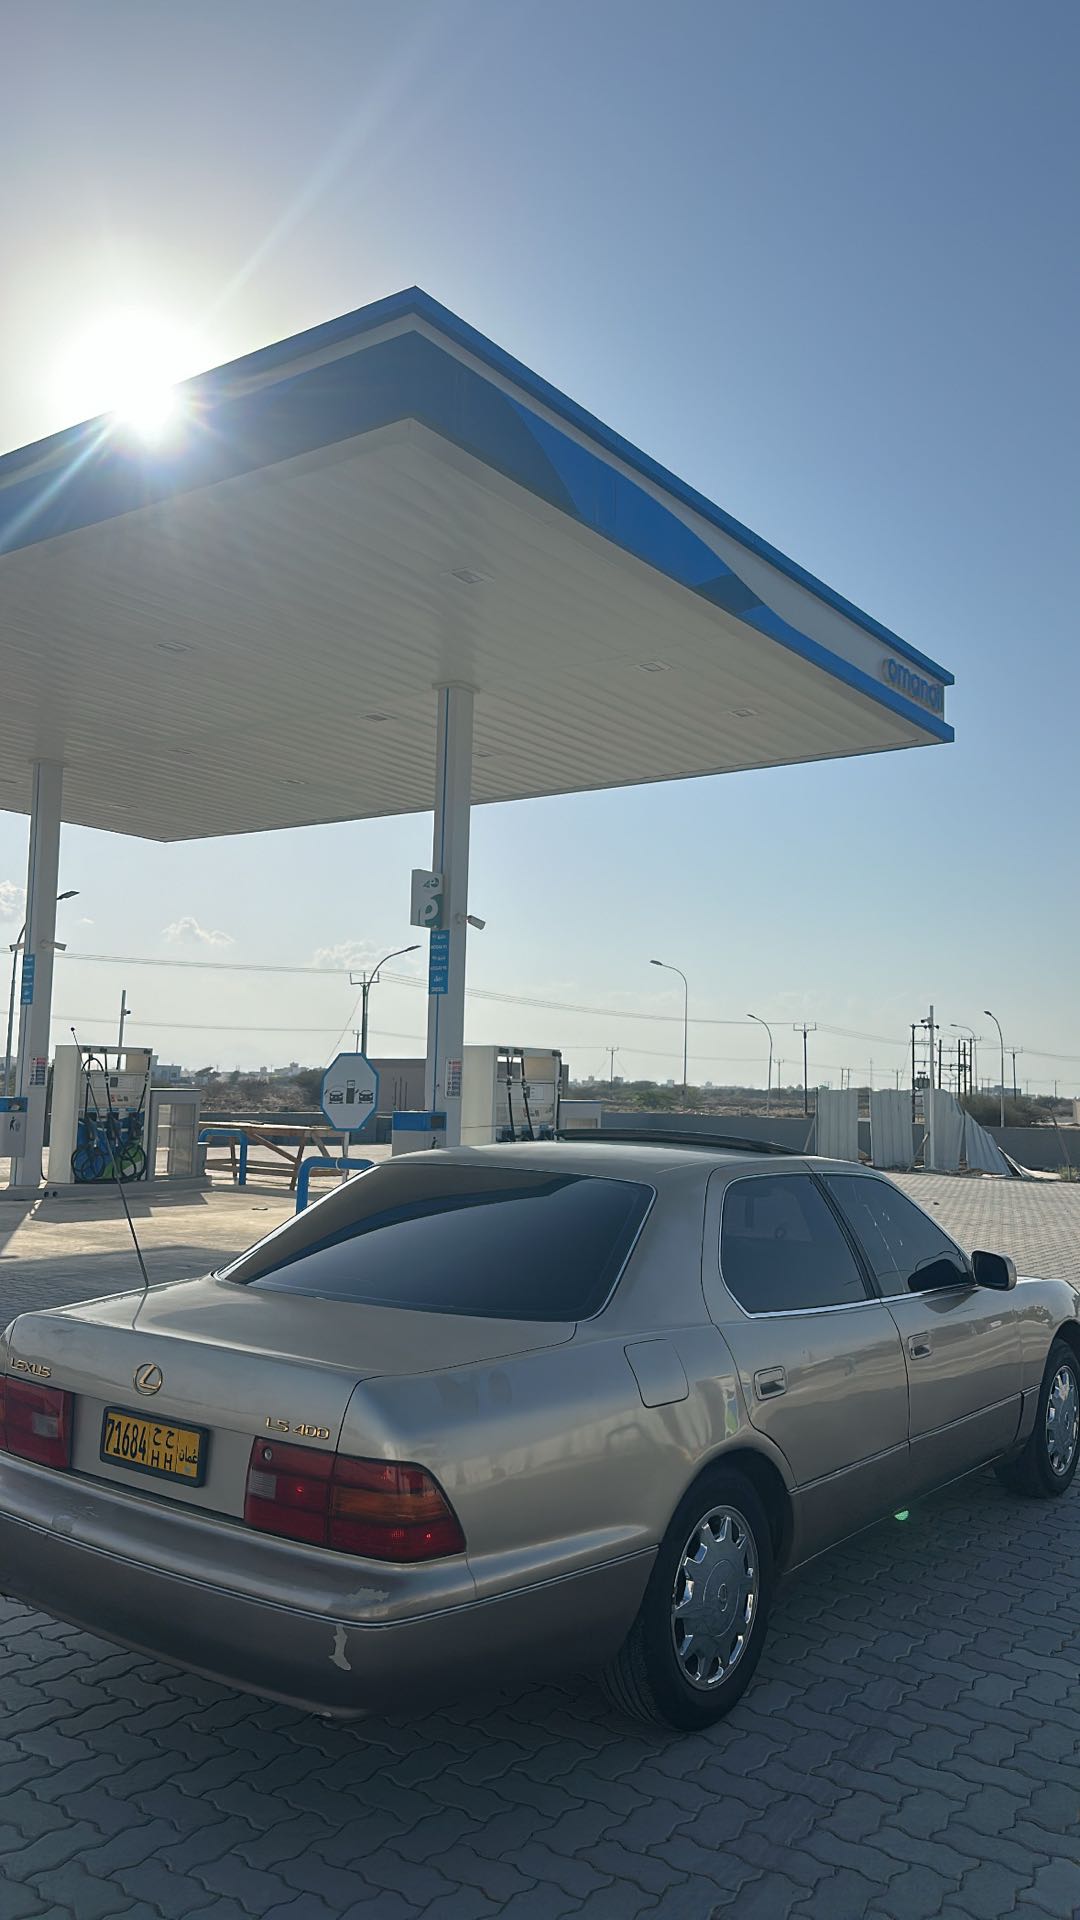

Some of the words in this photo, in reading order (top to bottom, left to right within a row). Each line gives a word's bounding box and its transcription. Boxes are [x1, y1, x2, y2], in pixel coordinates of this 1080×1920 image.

[10, 1357, 51, 1378] LEXUS
[105, 1418, 147, 1461] 71684
[266, 1416, 289, 1433] LS
[292, 1423, 330, 1440] 400
